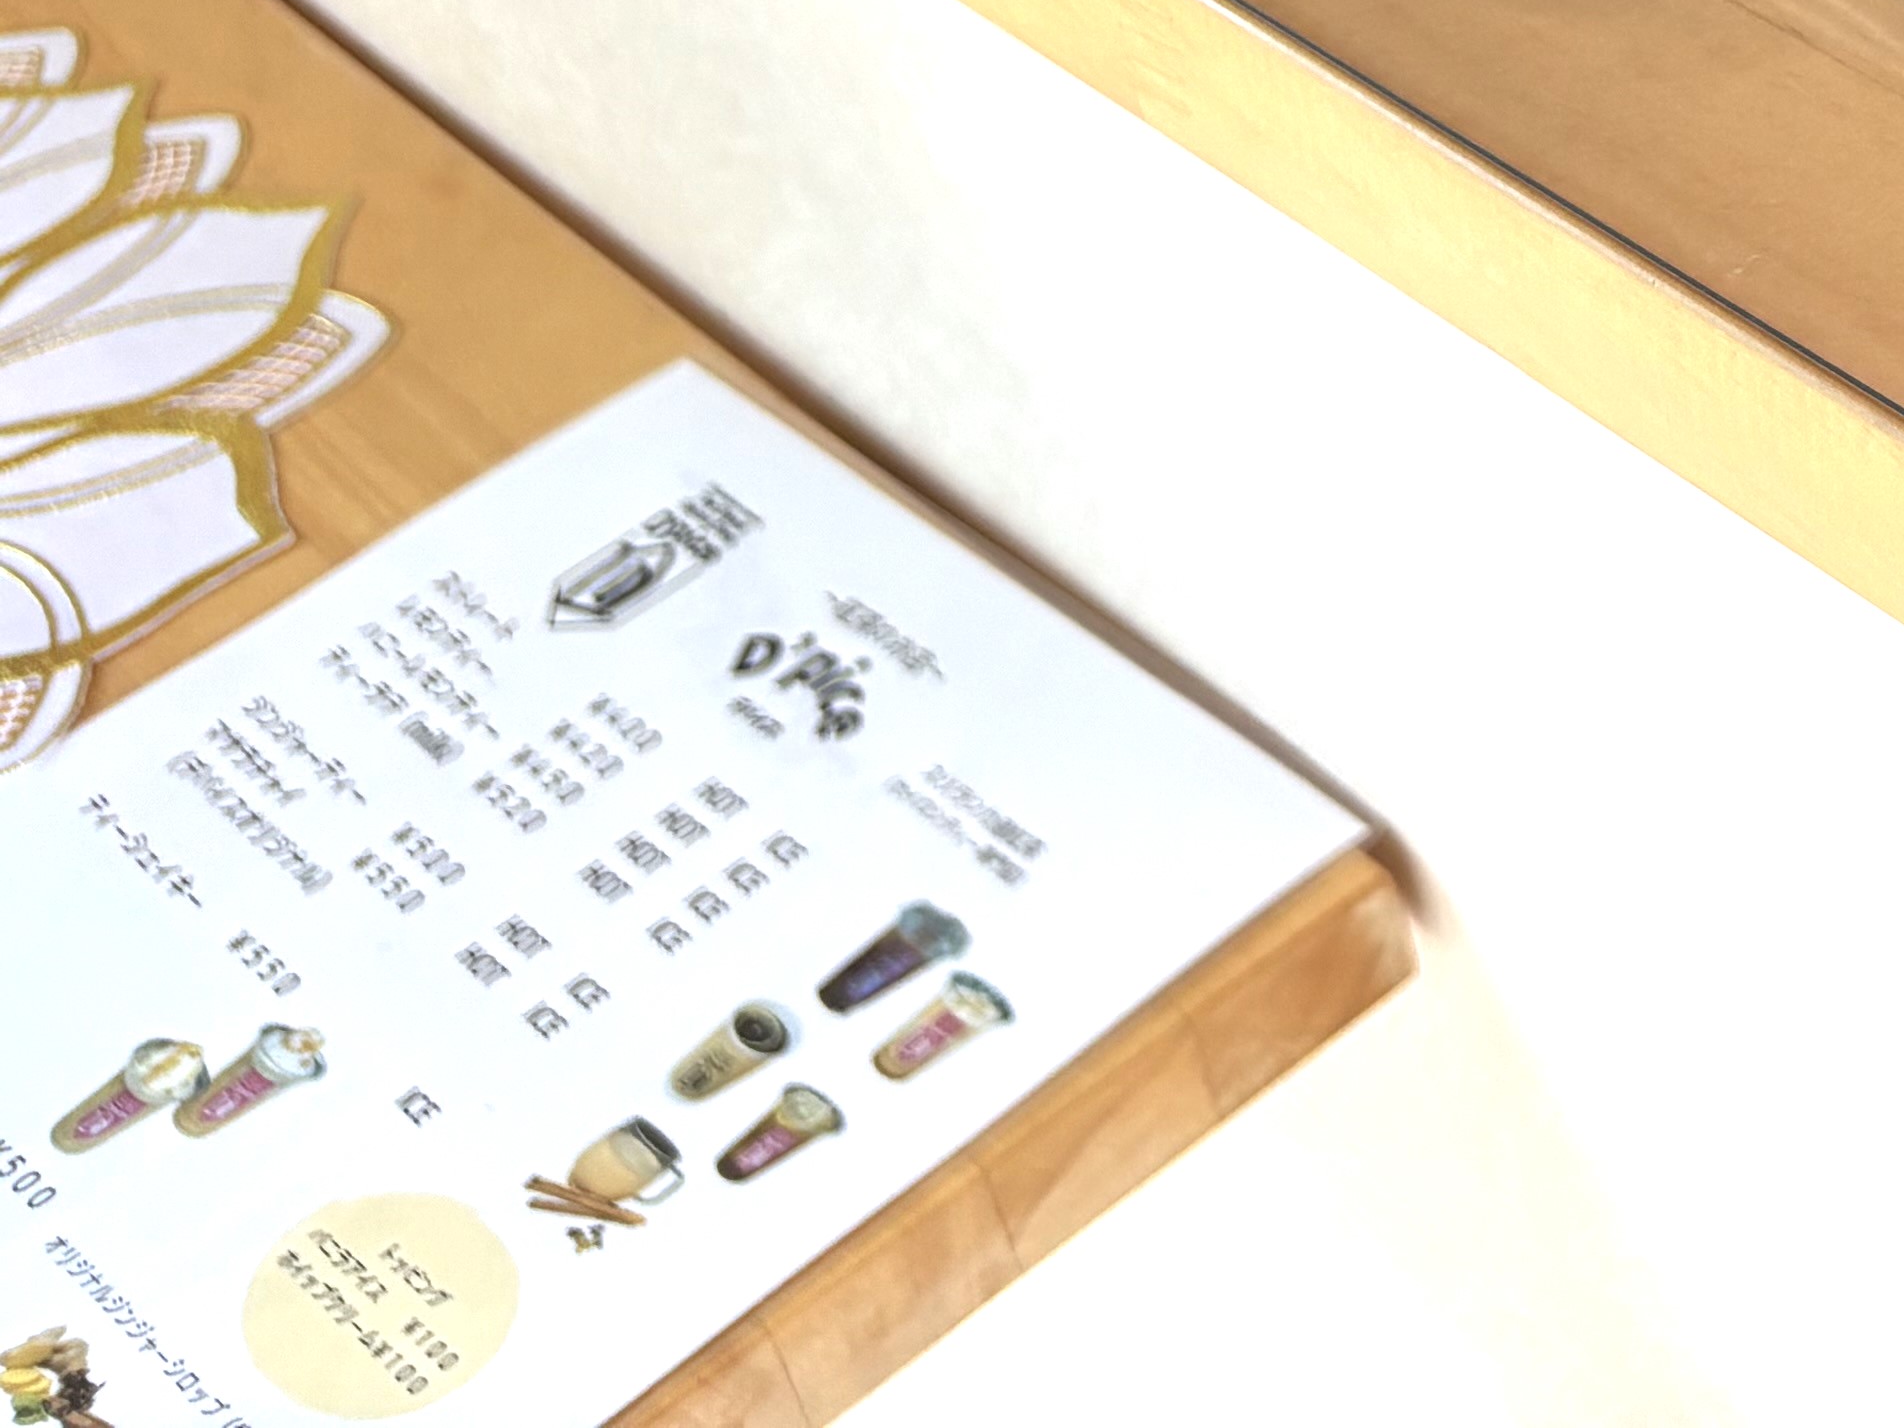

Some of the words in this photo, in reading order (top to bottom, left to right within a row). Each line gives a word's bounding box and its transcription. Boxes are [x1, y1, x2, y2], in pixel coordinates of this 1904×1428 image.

[562, 971, 611, 1012] ICE
[521, 999, 570, 1041] ICE
[394, 1086, 442, 1128] ICE
